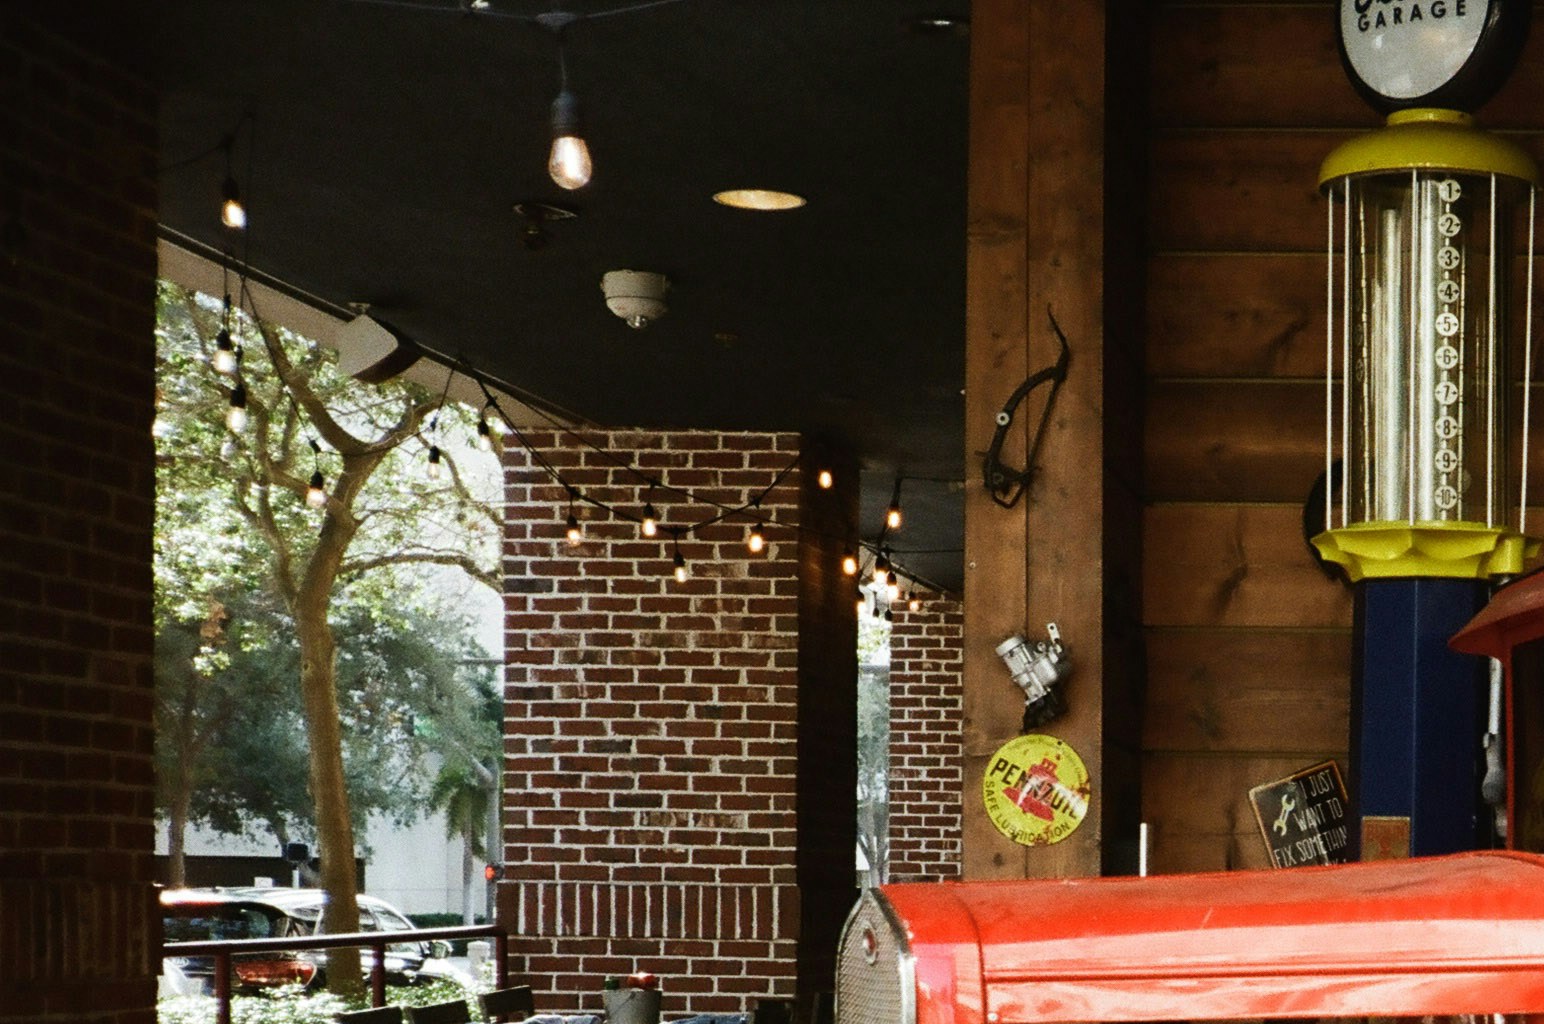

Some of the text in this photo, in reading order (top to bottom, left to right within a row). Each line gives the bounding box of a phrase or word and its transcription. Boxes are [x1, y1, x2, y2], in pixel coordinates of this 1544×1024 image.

[1357, 0, 1467, 32] GARAGE
[1300, 769, 1335, 800] I JUST
[985, 780, 1072, 843] SAFE LUBRICATION
[1292, 797, 1344, 832] WANT TO
[1273, 845, 1298, 870] FIX
